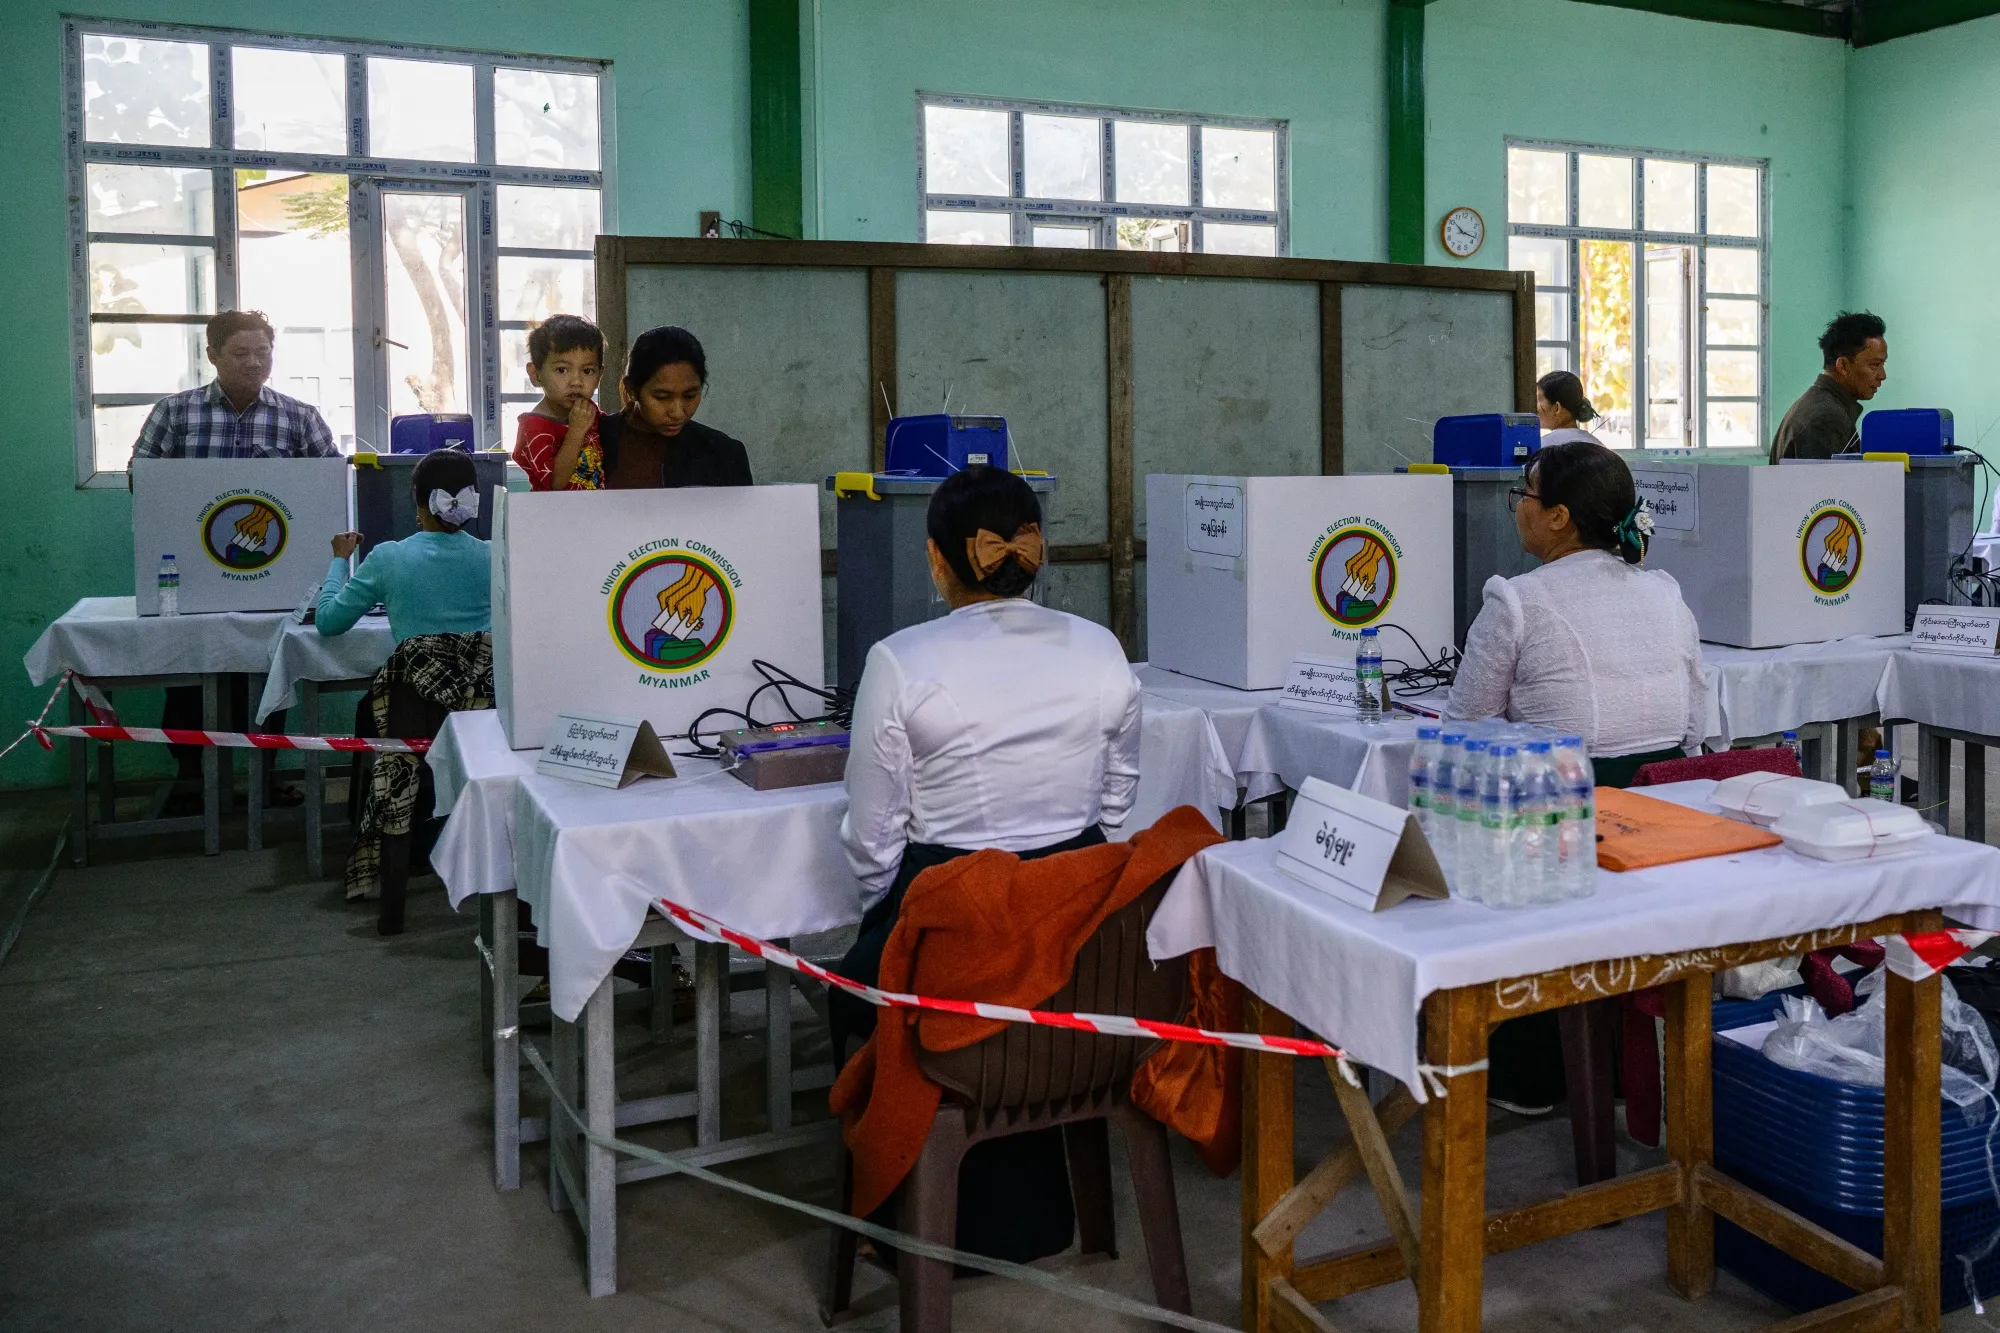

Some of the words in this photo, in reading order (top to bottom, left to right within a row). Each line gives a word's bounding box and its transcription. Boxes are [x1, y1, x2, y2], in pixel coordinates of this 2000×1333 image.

[196, 502, 214, 522] UNION
[215, 488, 250, 501] ELECTION
[254, 490, 293, 520] COMMISSION
[1796, 514, 1810, 538] UNION
[1810, 499, 1835, 514] ELECTION
[1839, 500, 1868, 535] COMMISSION
[1307, 535, 1325, 562] UNION
[1327, 516, 1360, 534] ELECTION
[1365, 518, 1403, 558] COMMISSION
[222, 570, 270, 581] MYANMAR
[600, 560, 626, 595] UNION
[628, 538, 678, 560] ELECTION
[686, 540, 743, 588] COMMISSION
[1814, 593, 1850, 606] MYANMAR
[1332, 628, 1359, 641] MYAN
[638, 670, 710, 688] MYANMAR
